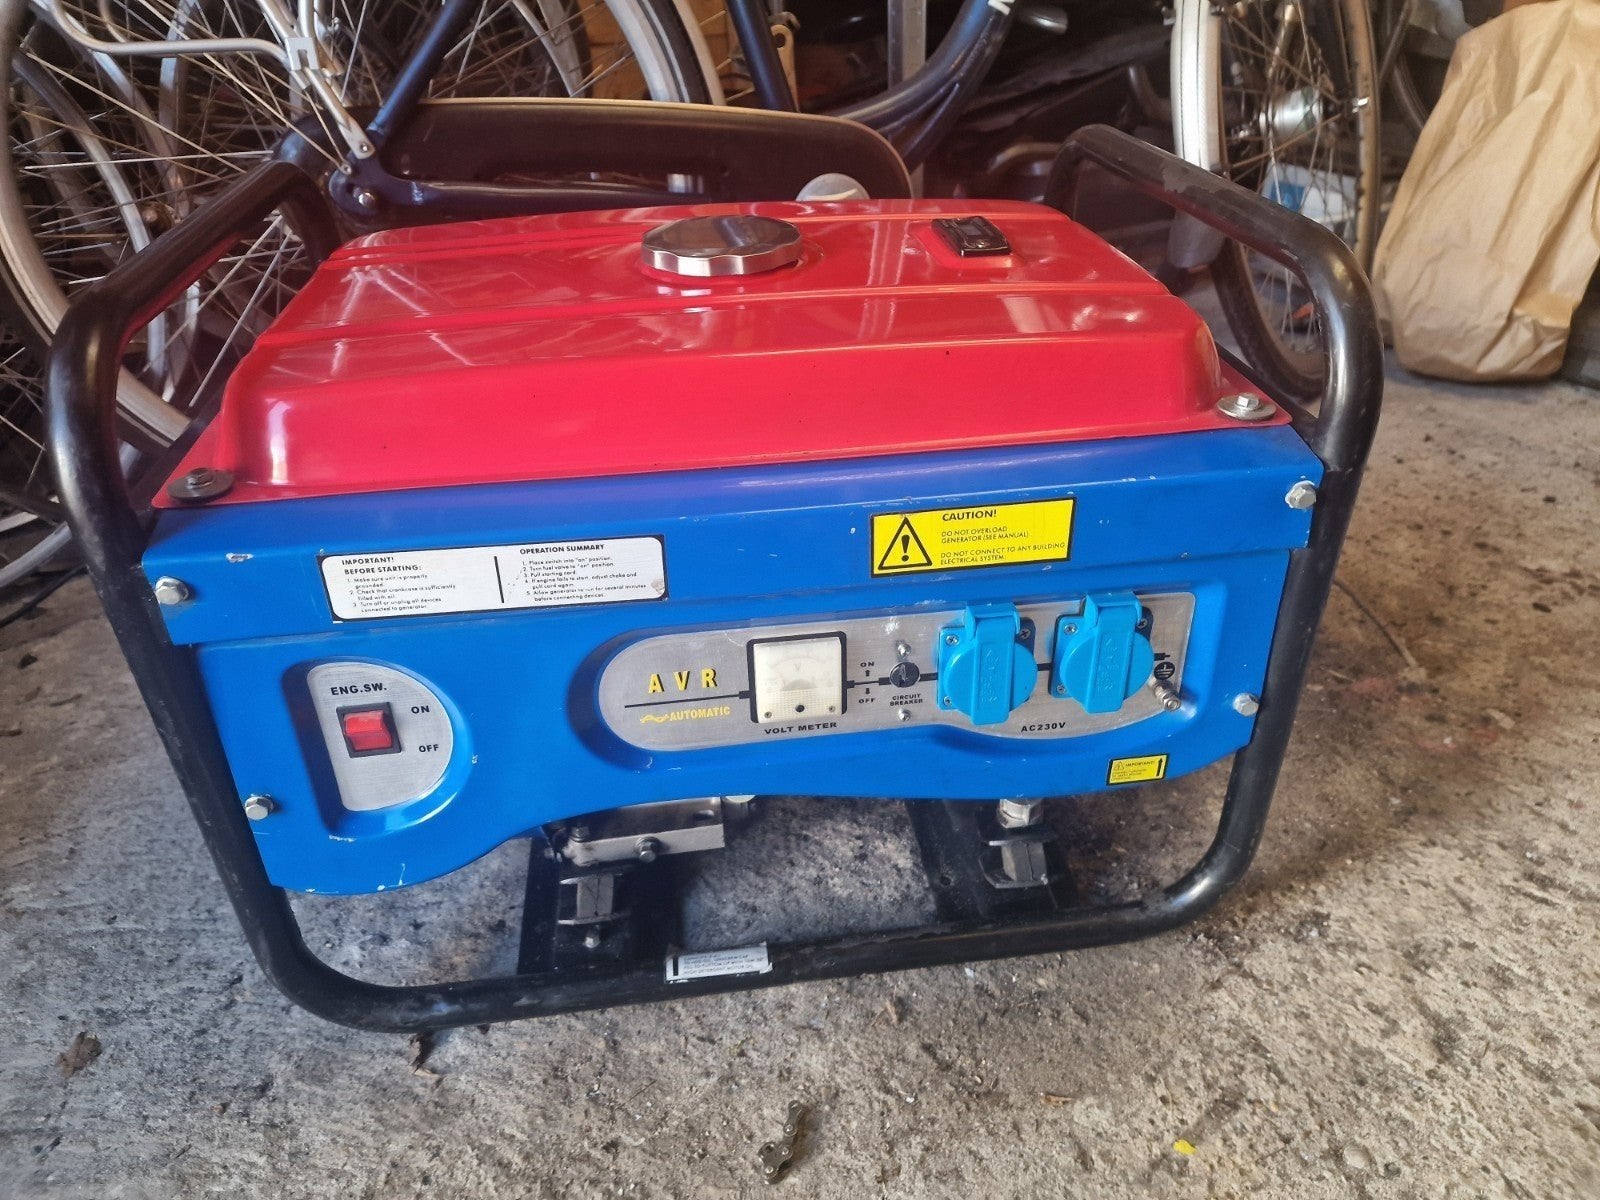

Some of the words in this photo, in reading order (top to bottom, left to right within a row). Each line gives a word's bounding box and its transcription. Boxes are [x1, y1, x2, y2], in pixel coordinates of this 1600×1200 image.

[942, 509, 997, 522] CAUTION!
[954, 529, 970, 537] NOT
[970, 526, 1008, 535] OVERLOAD
[942, 535, 982, 544] GENERATOR
[983, 534, 997, 542] (SEE
[520, 546, 564, 555] OPERATION
[566, 544, 604, 552] SUMMARY
[970, 548, 1006, 556] CONNECT
[1033, 542, 1066, 551] BUILDING
[342, 556, 394, 566] IMPORTANT!
[940, 556, 979, 565] ELECTRICAL
[344, 567, 376, 575] BEFORE
[378, 565, 422, 573] STARTING:
[331, 682, 387, 696] ENG.SW.
[411, 706, 430, 714] ON
[669, 706, 731, 721] AUTOMATIC
[764, 726, 794, 735] VOLT
[798, 722, 837, 731] METER
[1021, 722, 1066, 733] AC230V
[418, 744, 440, 753] OFF
